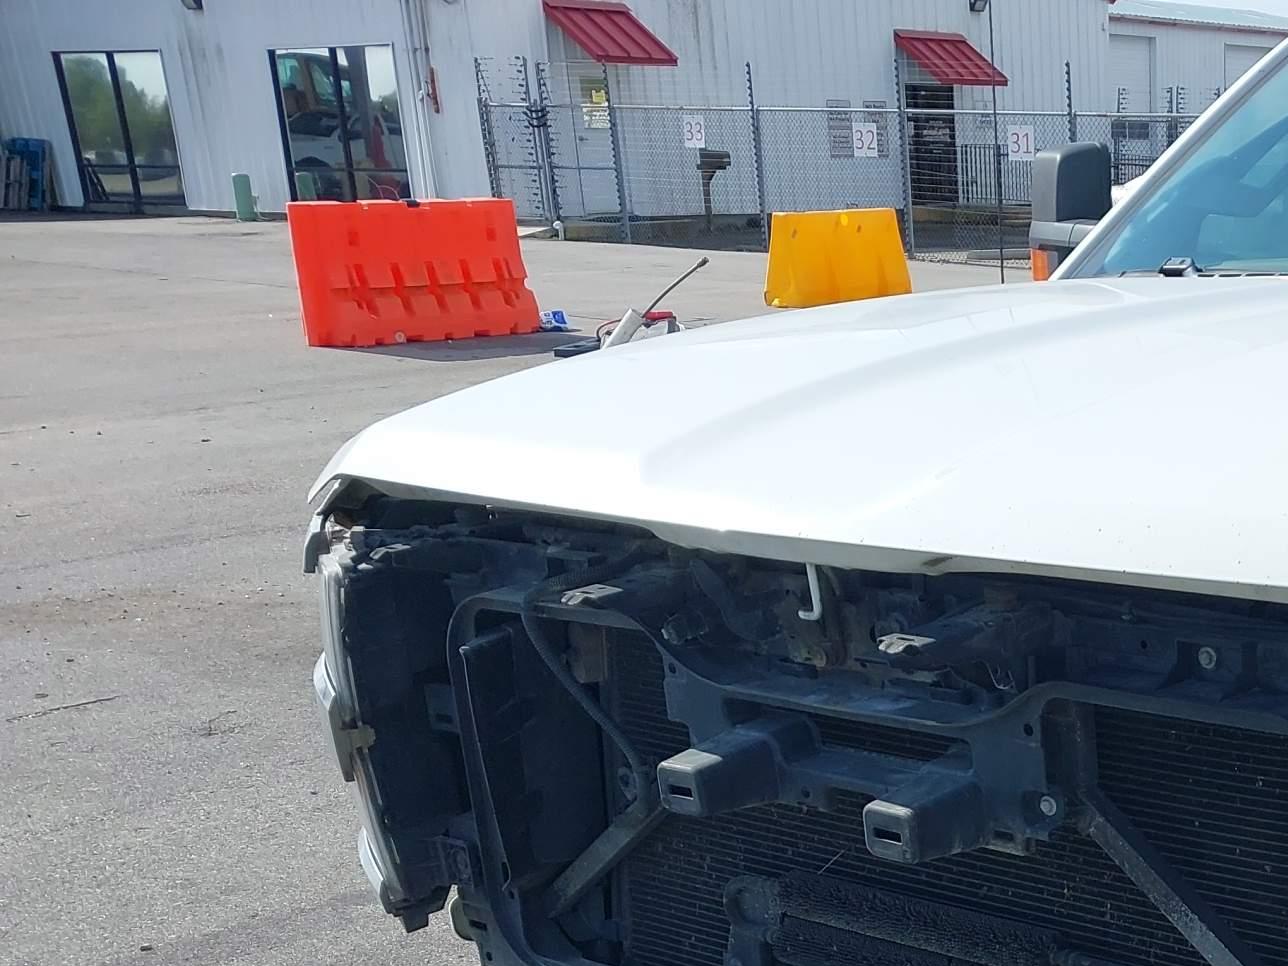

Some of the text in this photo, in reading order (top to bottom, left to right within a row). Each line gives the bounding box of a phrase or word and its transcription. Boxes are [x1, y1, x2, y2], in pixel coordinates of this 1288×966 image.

[684, 121, 704, 142] 33
[854, 129, 877, 151] 32
[1010, 132, 1032, 154] 31
